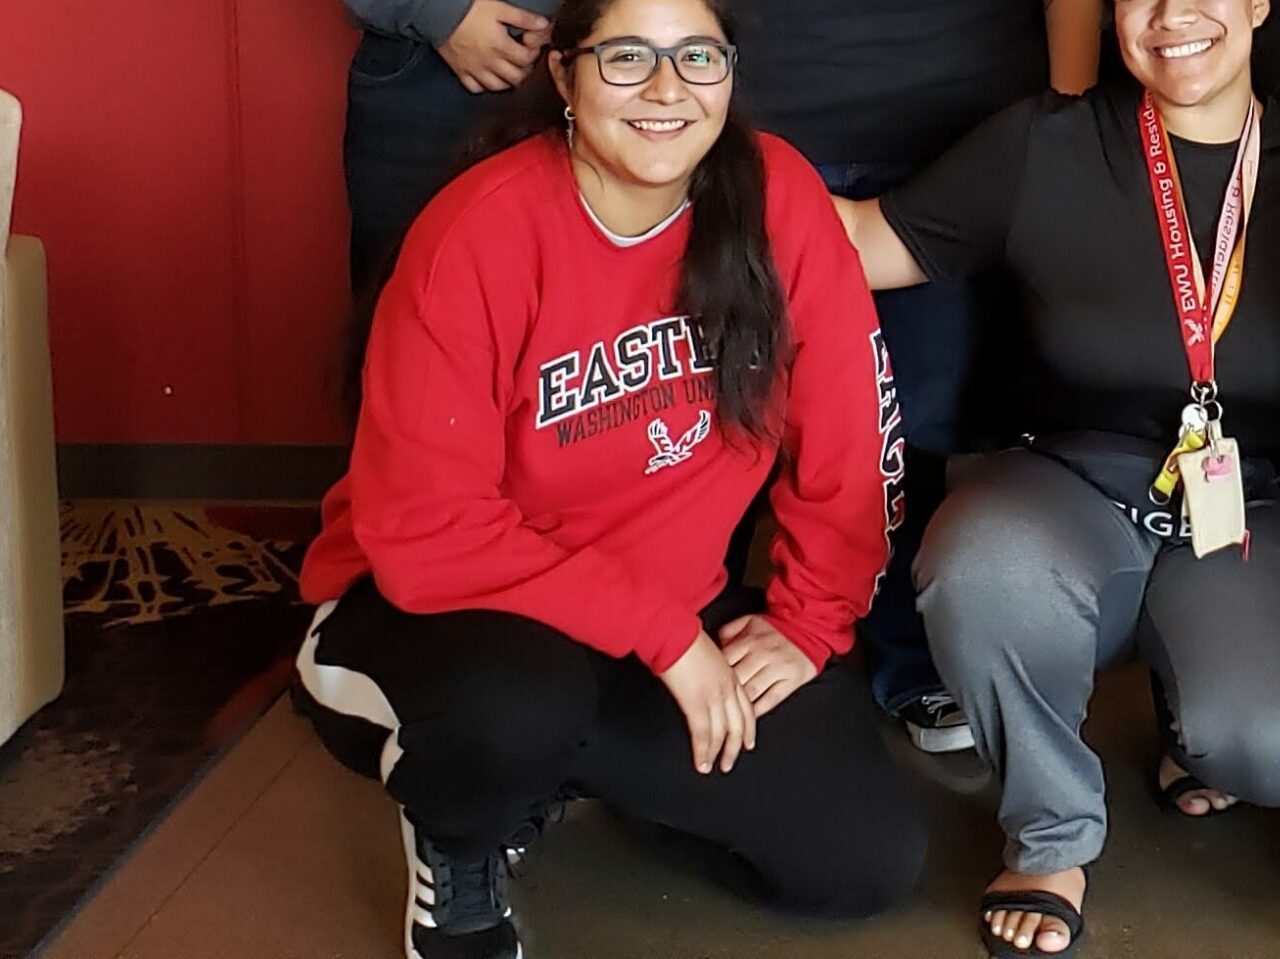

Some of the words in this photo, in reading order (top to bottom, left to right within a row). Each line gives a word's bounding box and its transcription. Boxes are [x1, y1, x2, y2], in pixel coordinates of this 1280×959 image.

[1153, 161, 1167, 175] &
[1158, 177, 1186, 260] Housing
[1173, 263, 1196, 313] EWU
[555, 382, 677, 448] WASHINGTON
